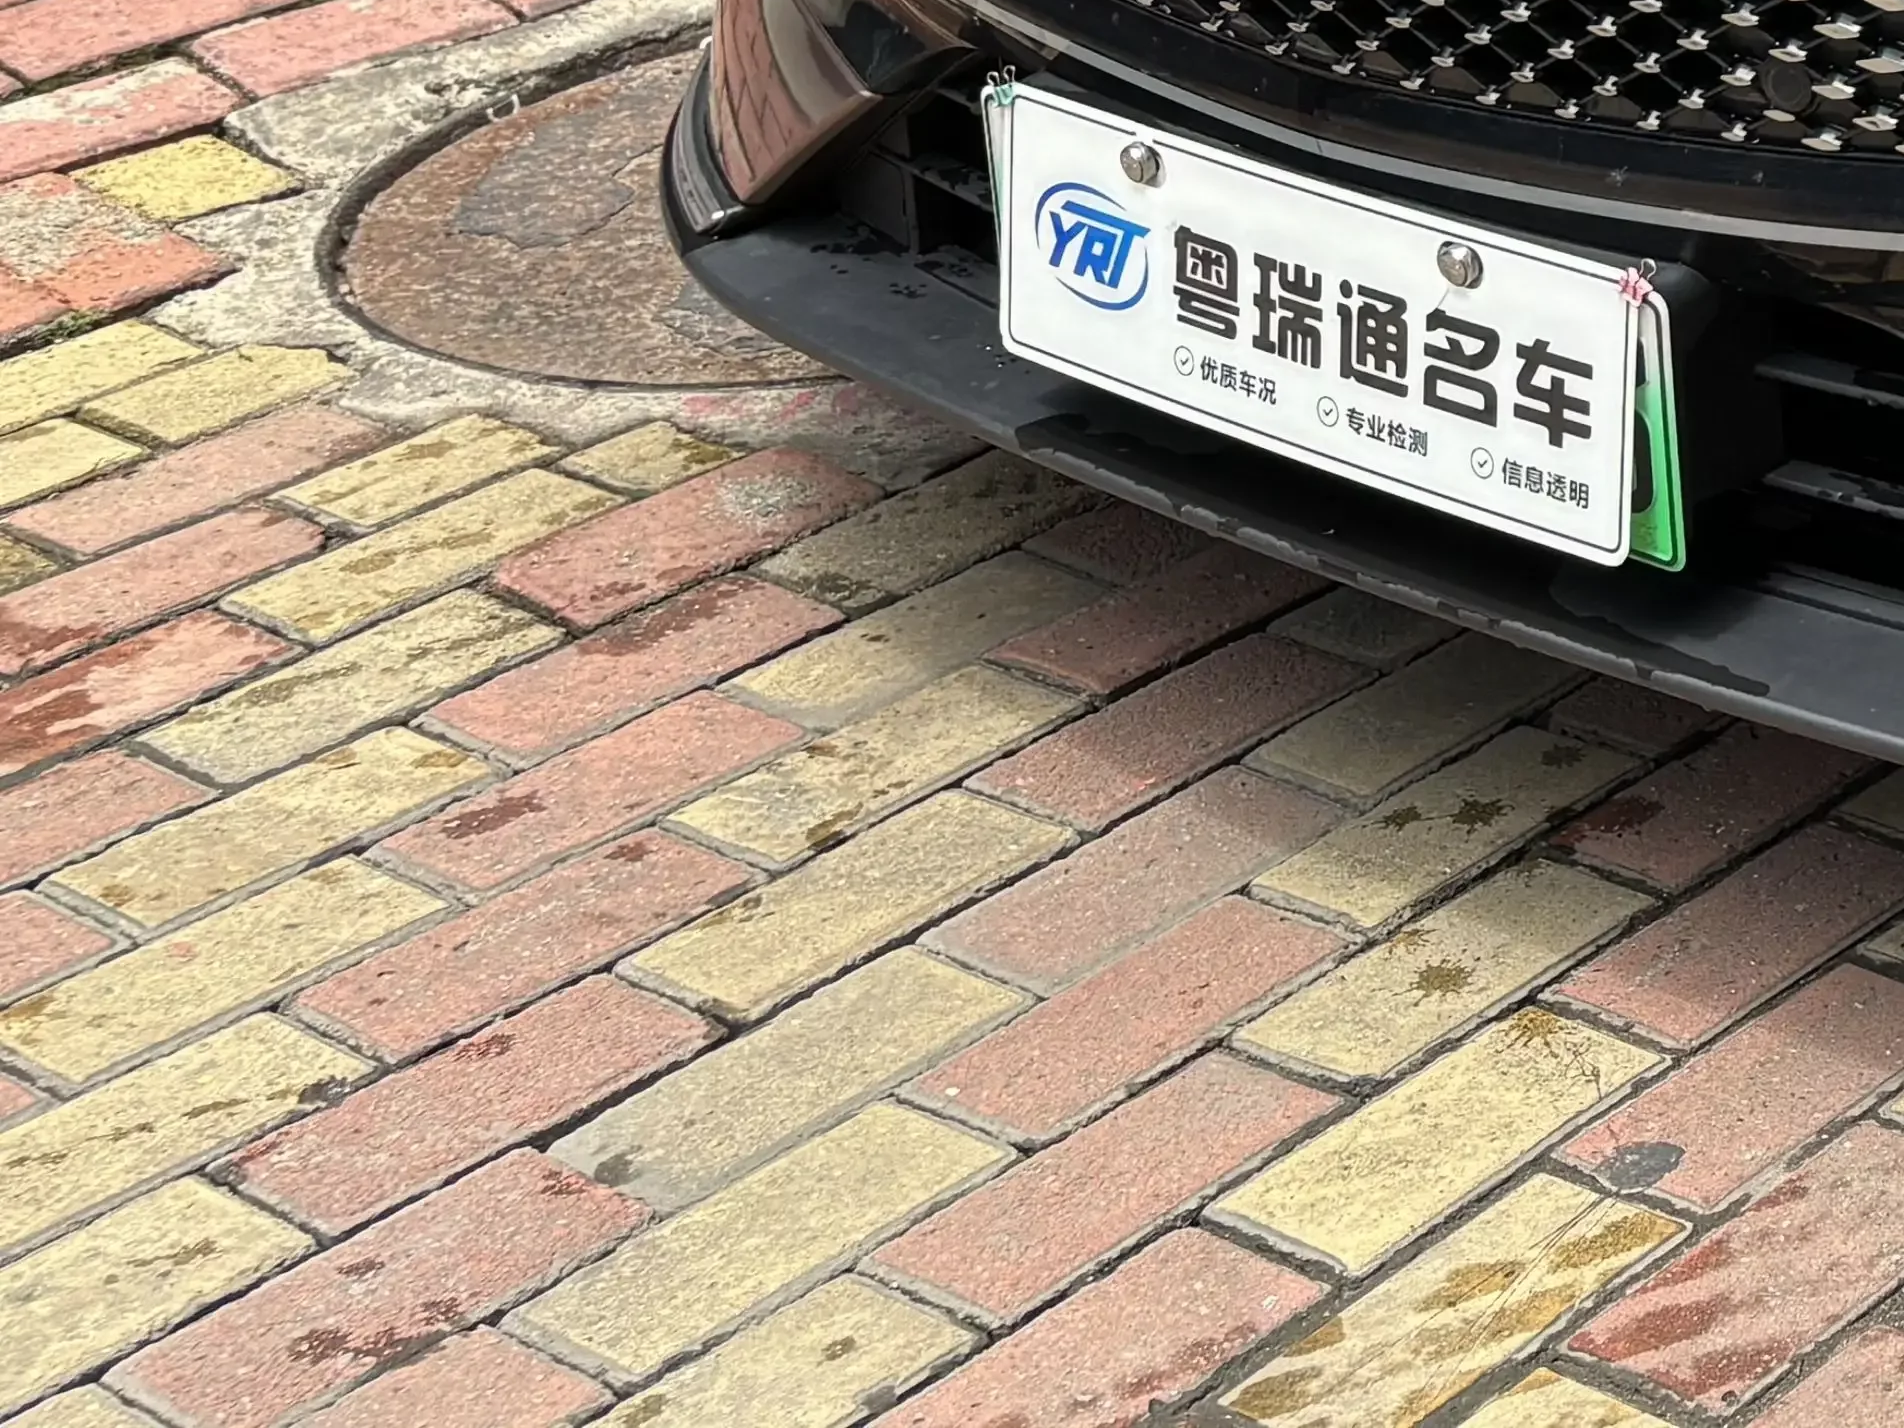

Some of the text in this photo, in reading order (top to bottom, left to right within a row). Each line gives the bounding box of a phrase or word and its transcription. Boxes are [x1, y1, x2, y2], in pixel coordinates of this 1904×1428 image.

[1048, 198, 1151, 290] YRT
[1172, 224, 1595, 449] 粤瑞通名车
[1199, 354, 1279, 407] 优质车况
[1345, 405, 1430, 458] 专业检测
[1500, 456, 1592, 511] 信息透明
